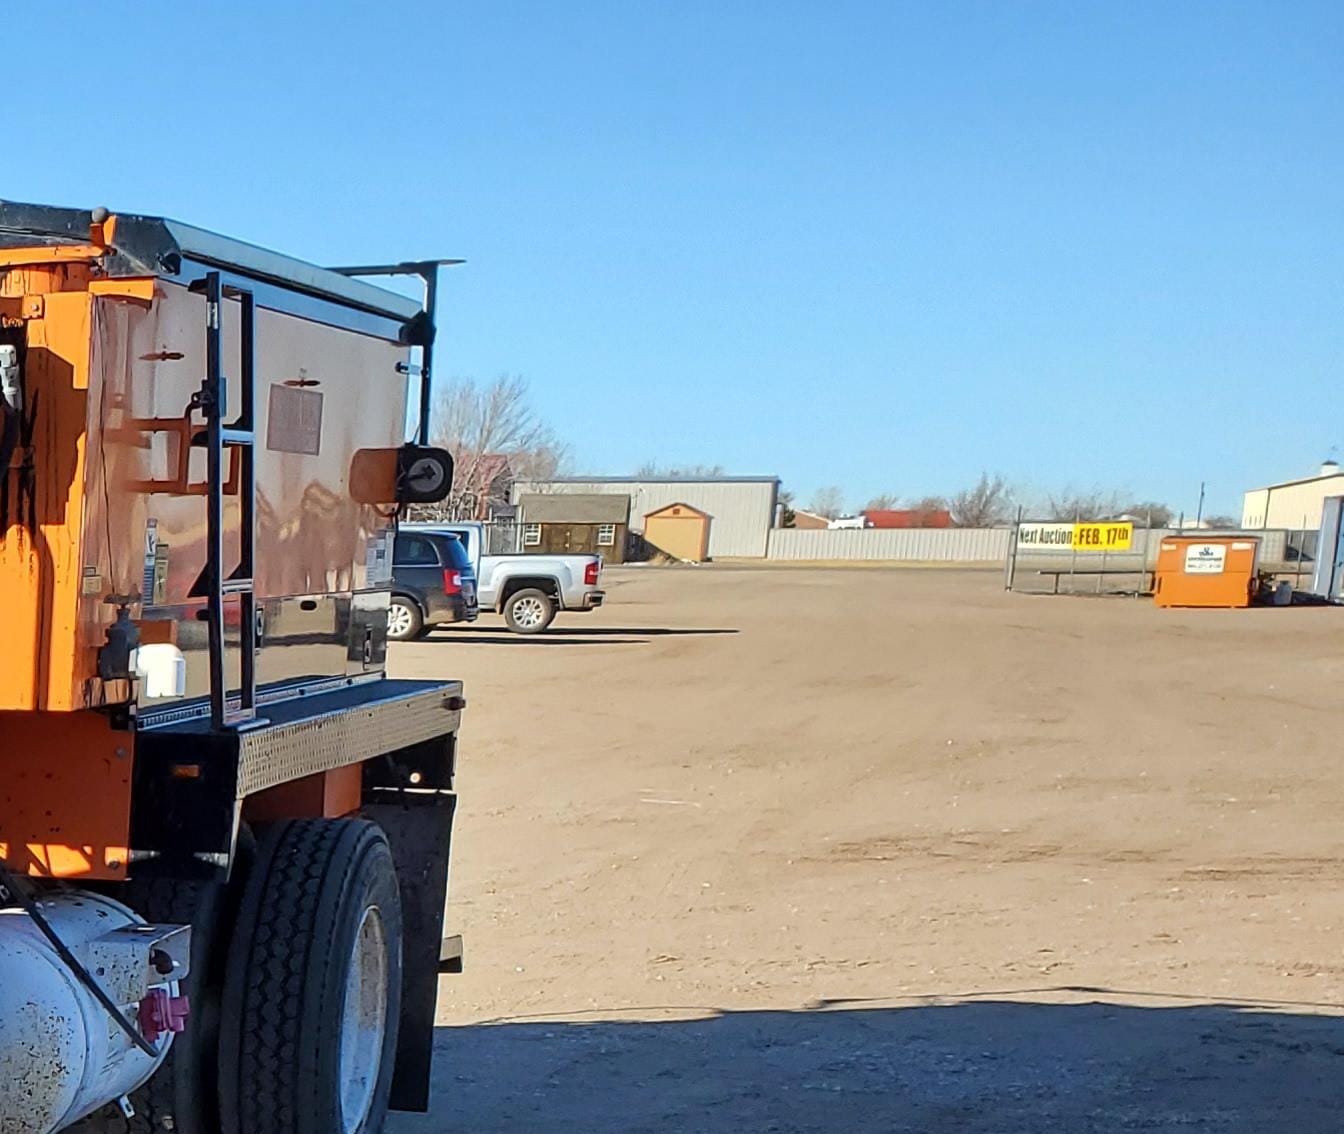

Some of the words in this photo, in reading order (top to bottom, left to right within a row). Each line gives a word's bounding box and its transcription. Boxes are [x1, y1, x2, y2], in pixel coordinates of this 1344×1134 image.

[1019, 527, 1038, 543] Next
[1079, 527, 1103, 545] FEB.
[1106, 527, 1128, 545] 17th
